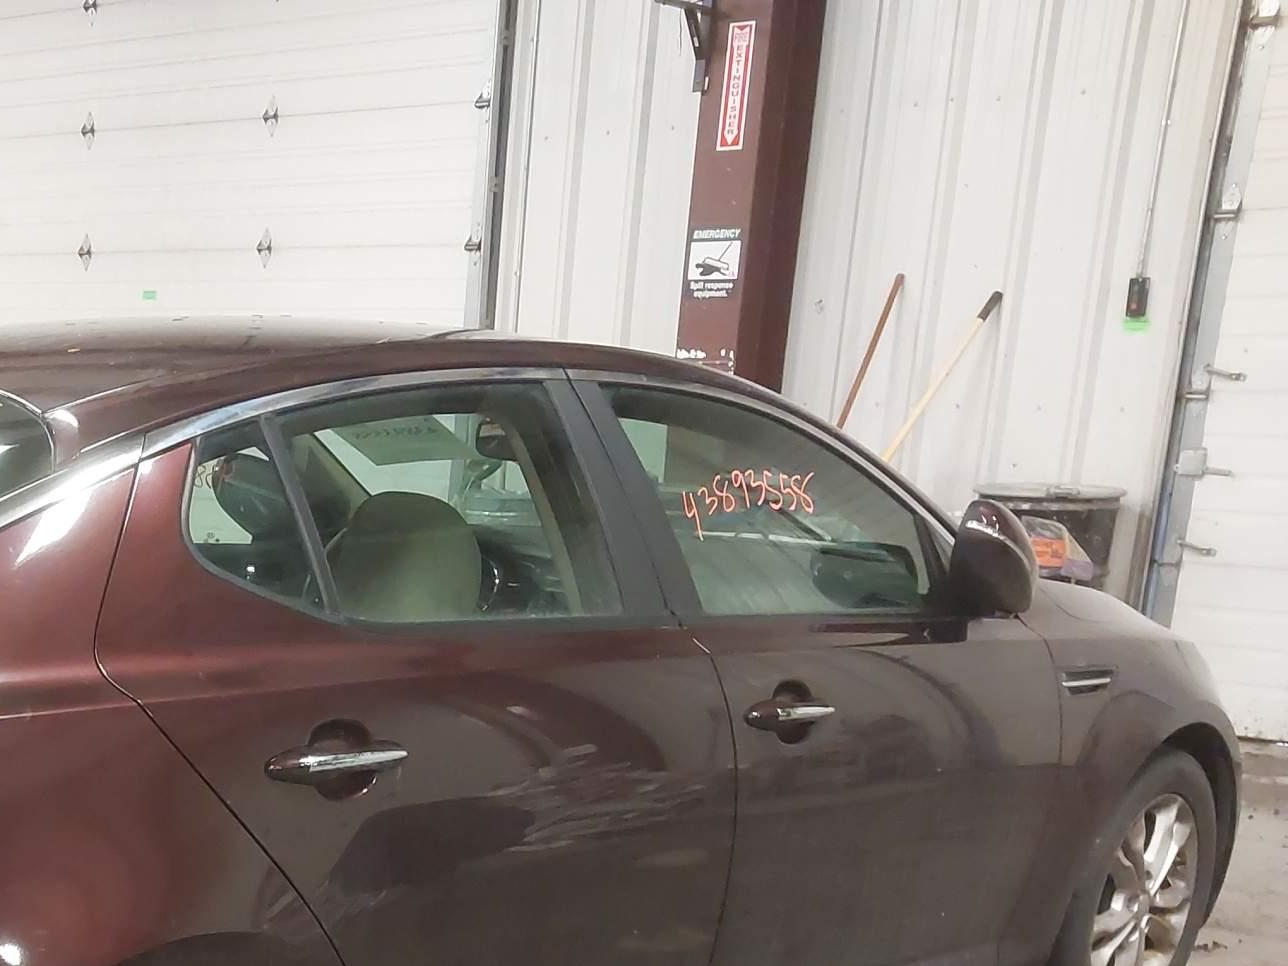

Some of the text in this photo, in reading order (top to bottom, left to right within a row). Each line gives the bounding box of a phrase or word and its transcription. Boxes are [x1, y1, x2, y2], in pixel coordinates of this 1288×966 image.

[727, 44, 744, 135] EXTINGUISHER
[693, 229, 741, 239] EMERGENCY
[682, 469, 815, 542] 43893558
